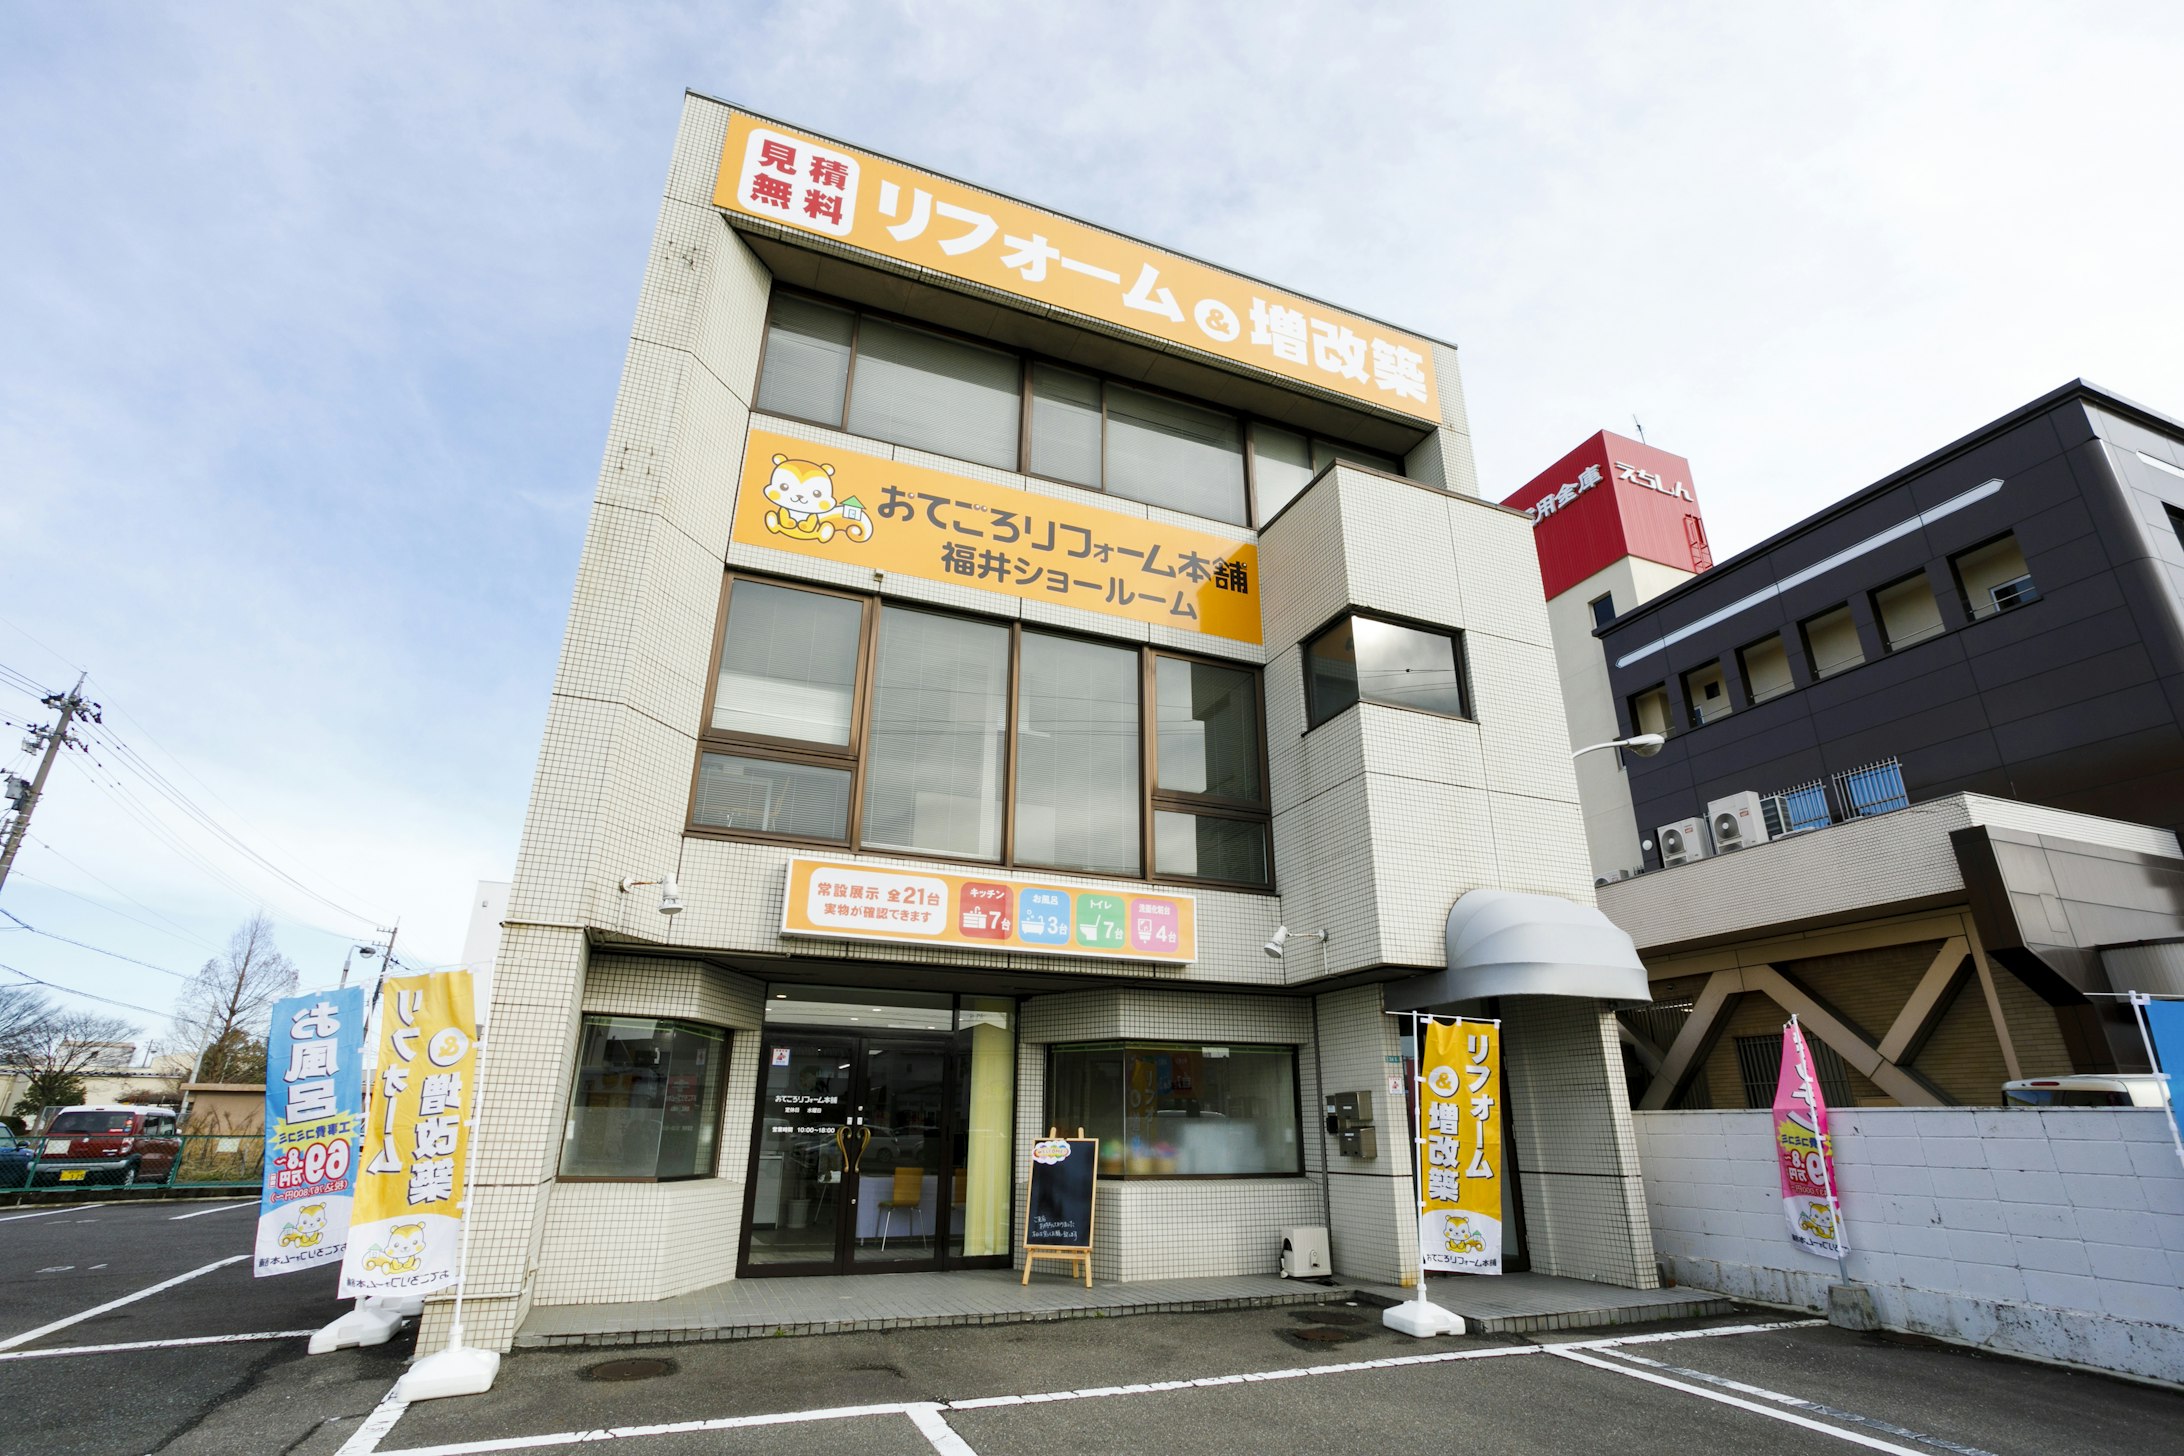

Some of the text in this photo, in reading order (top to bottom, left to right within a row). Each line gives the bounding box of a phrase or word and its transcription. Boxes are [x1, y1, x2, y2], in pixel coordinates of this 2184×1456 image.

[758, 138, 850, 192] 見積
[750, 173, 844, 226] 無料
[941, 541, 1198, 620] 福井ショールーム
[817, 882, 940, 906] 常設展示 全21台
[969, 888, 1005, 900] キッチン
[1032, 894, 1059, 906] お風呂
[1090, 899, 1112, 909] トイレ
[824, 903, 931, 922] 実物が確認できます
[989, 911, 1011, 931] 7台
[1047, 916, 1068, 936] 3台
[1103, 921, 1123, 940] 7台
[1155, 925, 1177, 943] 4台
[1465, 1034, 1495, 1180] リフォーム
